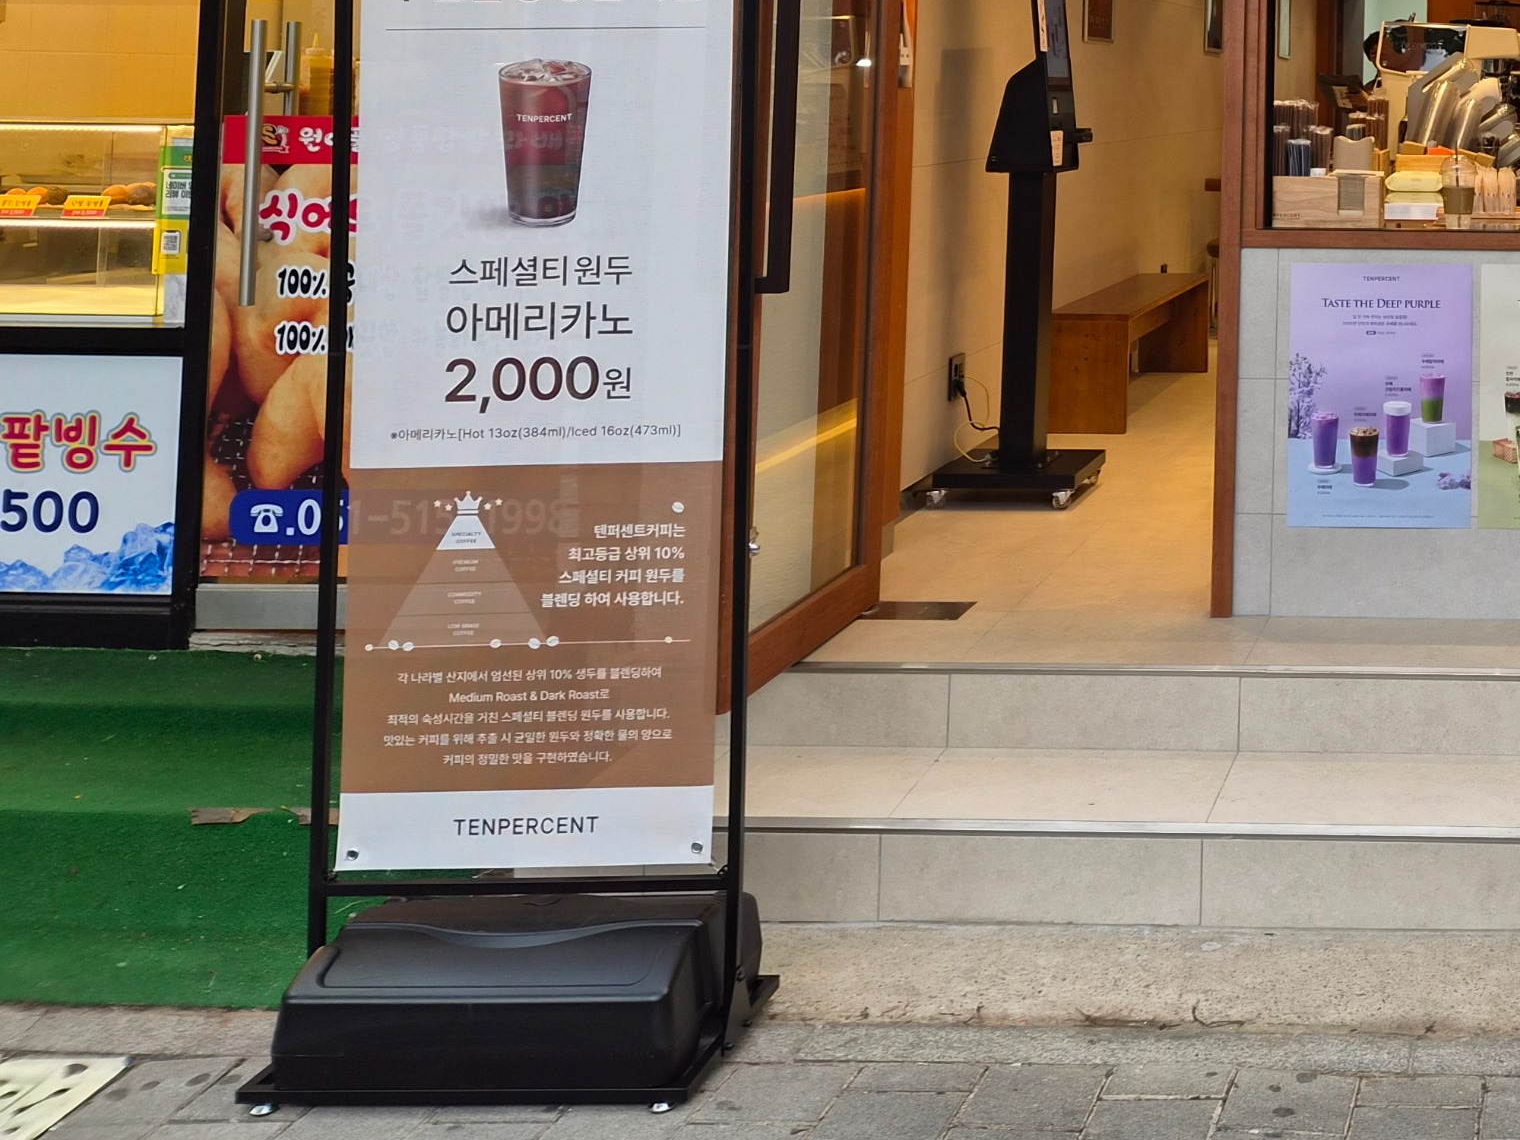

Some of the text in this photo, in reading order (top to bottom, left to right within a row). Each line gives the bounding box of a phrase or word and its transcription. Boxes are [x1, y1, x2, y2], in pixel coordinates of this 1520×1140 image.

[516, 112, 573, 124] TENPERCENT
[277, 267, 327, 297] 100%
[1321, 297, 1441, 309] TASTE THE DEEP PURPLE
[445, 301, 634, 342] 아메리카노
[275, 323, 326, 352] 100%
[444, 355, 632, 414] 2,000원
[1, 409, 157, 473] 팥빙수
[593, 522, 685, 539] 텐퍼센트커피는
[568, 545, 684, 562] 최고등급 상위 10%
[558, 567, 684, 585] 스페셜티 커피 원두를
[540, 589, 683, 608] 블렌딩 하여 사용합니다.
[397, 666, 661, 684] 각 나라별 산지에서 엄선된 상위 10% 생두를 블렌딩하여
[448, 688, 609, 703] Medium Roast & Dark Roast로
[453, 816, 600, 837] TENPERCENT
